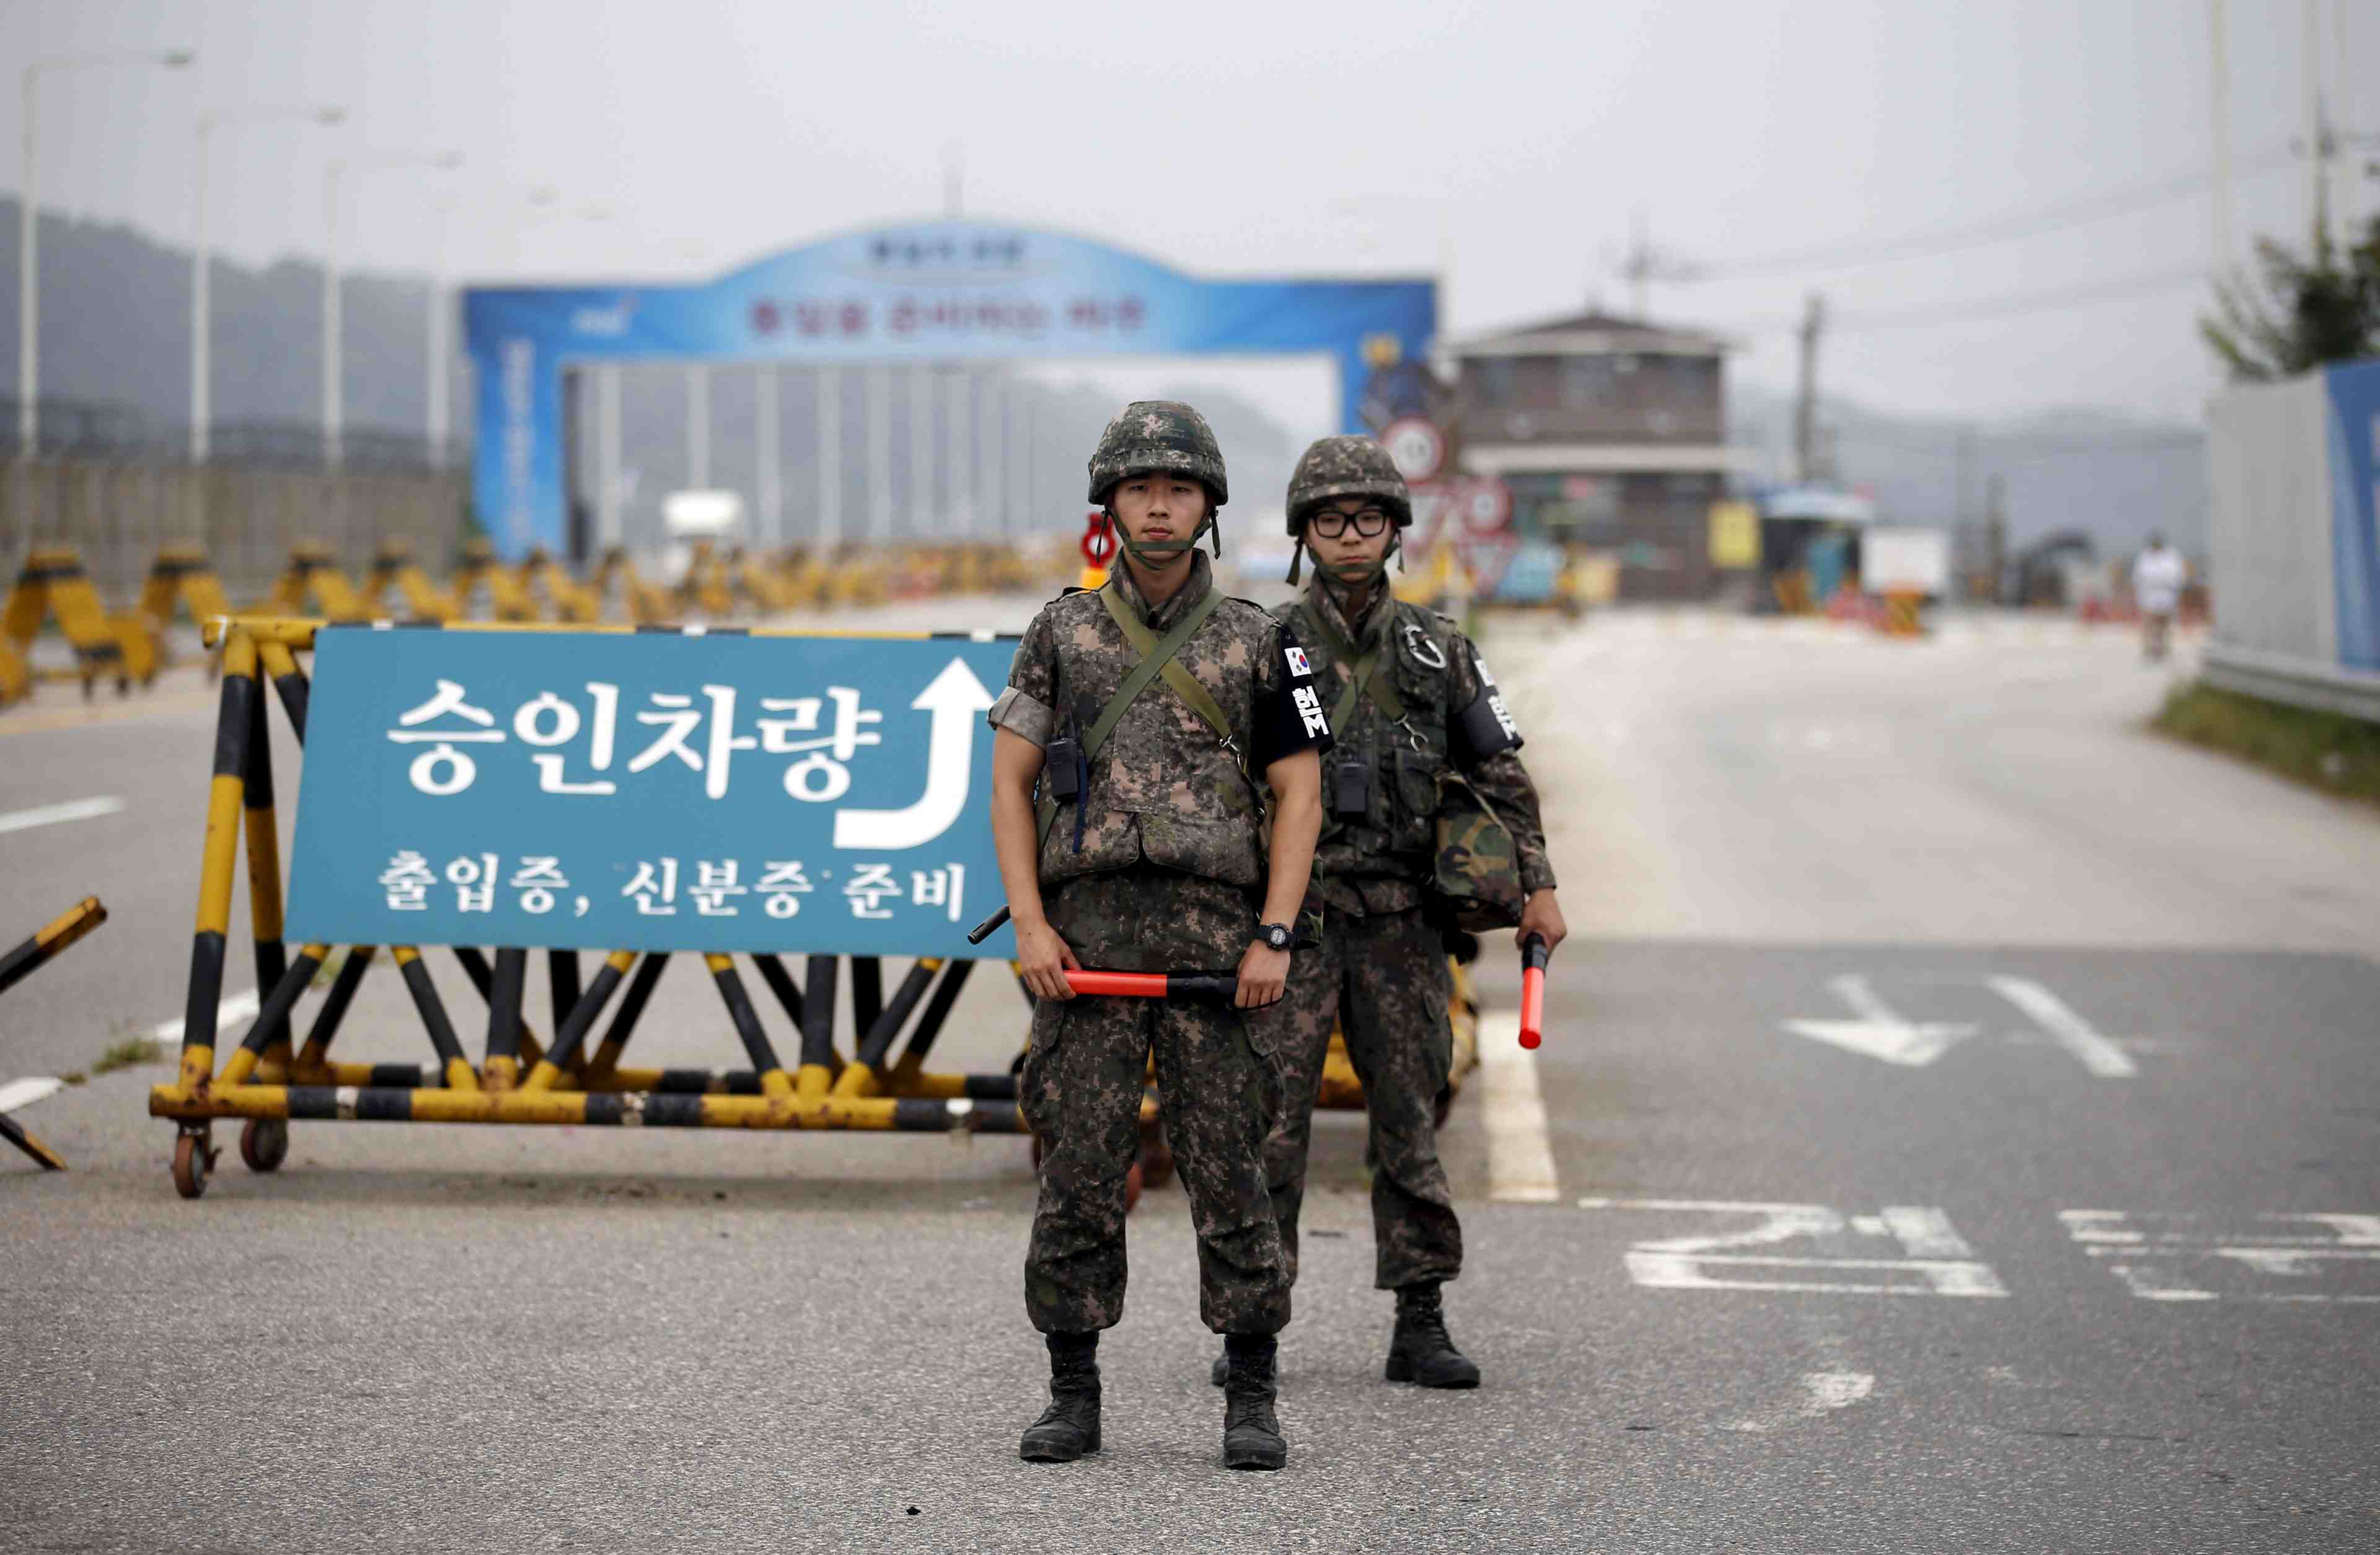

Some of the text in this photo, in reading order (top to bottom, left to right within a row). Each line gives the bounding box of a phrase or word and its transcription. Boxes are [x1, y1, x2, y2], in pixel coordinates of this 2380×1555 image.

[387, 679, 883, 802] 승인차량
[379, 850, 966, 922] 출입증, 신분증 준비
